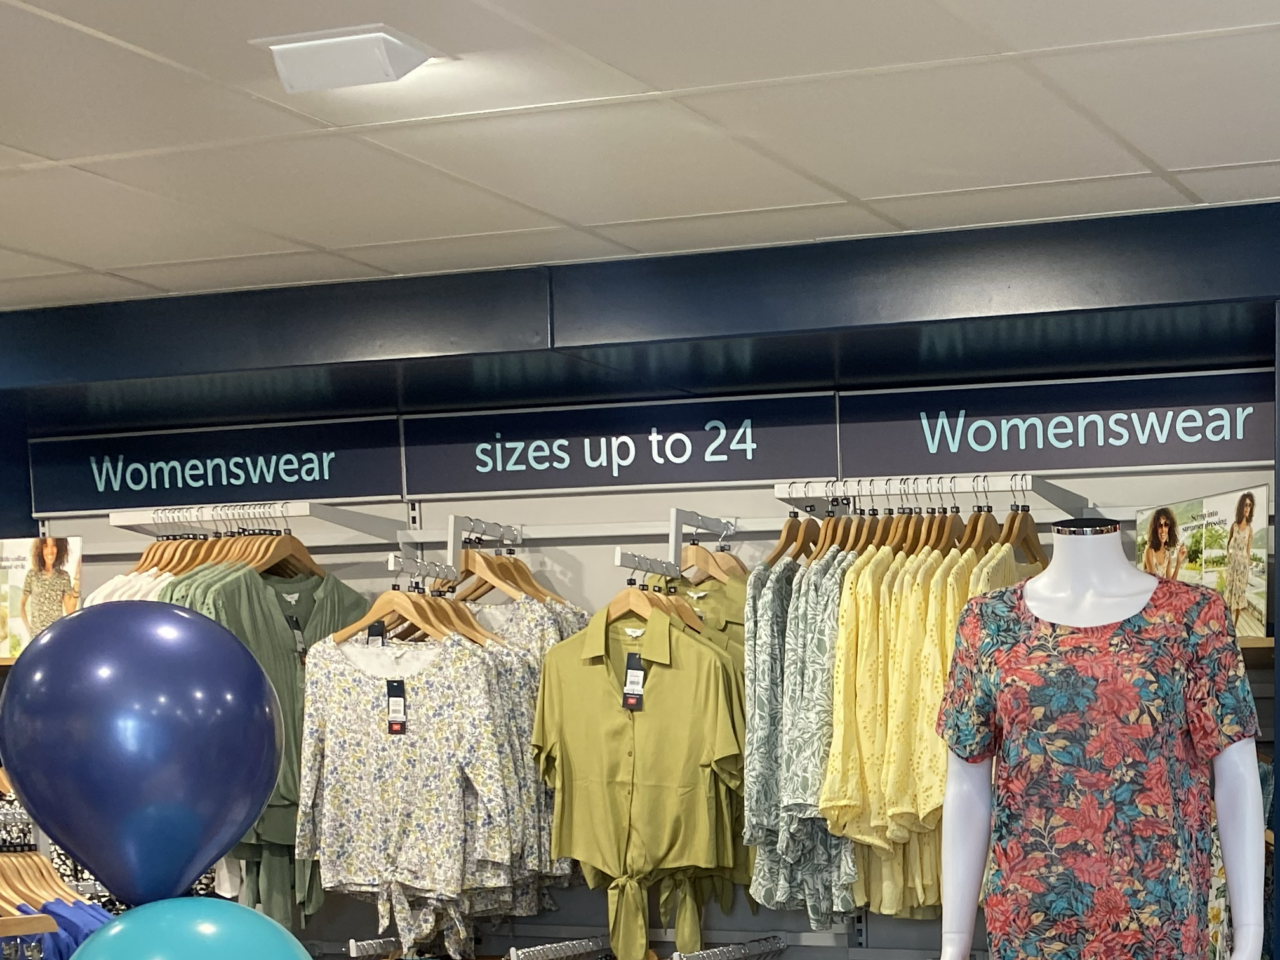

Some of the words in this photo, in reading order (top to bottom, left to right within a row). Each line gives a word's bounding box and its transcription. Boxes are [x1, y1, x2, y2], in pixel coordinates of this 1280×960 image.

[476, 434, 570, 472] sizes
[584, 436, 635, 476] up
[649, 428, 692, 464] to
[705, 420, 756, 461] 24
[921, 407, 1253, 453] Womenswear
[92, 452, 335, 491] Womenswear
